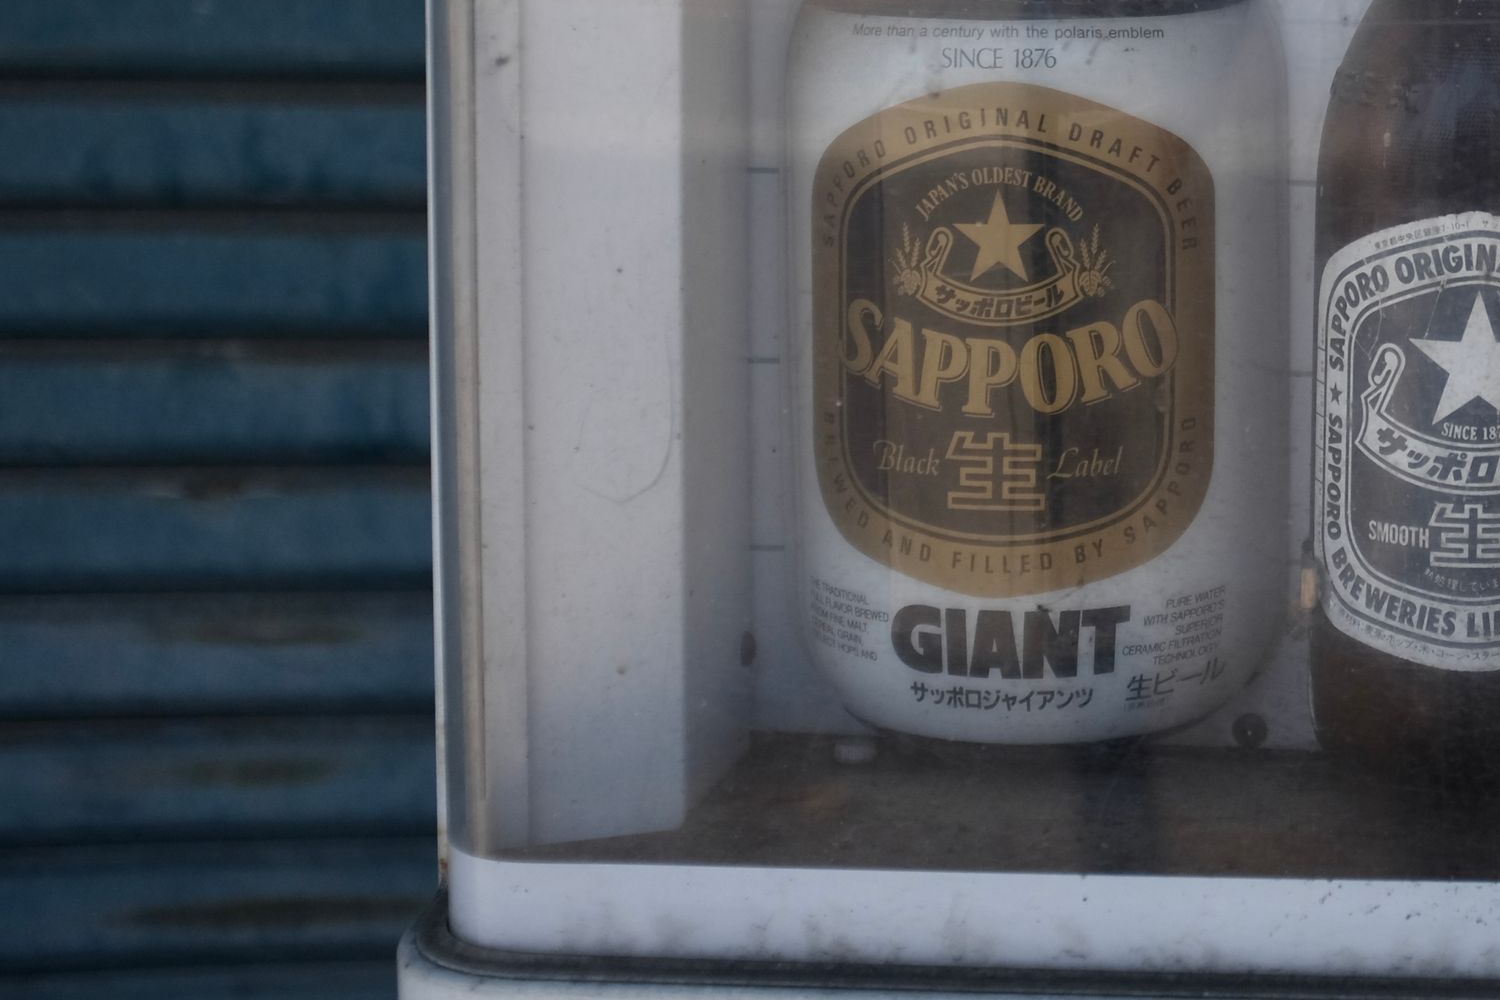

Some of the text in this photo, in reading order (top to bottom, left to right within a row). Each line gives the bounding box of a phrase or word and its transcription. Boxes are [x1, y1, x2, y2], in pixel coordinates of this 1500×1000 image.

[852, 24, 882, 37] More
[887, 25, 914, 37] than
[919, 28, 928, 37] a
[932, 27, 984, 40] century
[990, 25, 1019, 38] with
[1026, 25, 1049, 38] the
[1107, 26, 1165, 40] emblem
[941, 47, 1057, 69] SINCE 1876
[902, 107, 1048, 145] ORIGINAL
[1068, 122, 1161, 173] DRAFT
[1165, 178, 1199, 252] BEER
[914, 165, 1085, 223] JAPAN'S OLDEST BRAND
[934, 284, 1064, 318] サッポロビール
[1328, 265, 1390, 373] SAPPORO
[839, 299, 1180, 418] SAPPORO
[1441, 422, 1478, 441] SINCE
[872, 439, 940, 477] Black
[1046, 446, 1123, 480] Label
[1326, 413, 1343, 541] SAPPORO
[882, 530, 931, 563] AND
[951, 550, 1053, 575] FILLED
[1074, 539, 1105, 565] BY
[1123, 416, 1198, 545] SAPPORO
[1367, 519, 1430, 550] SMOOTH
[1166, 585, 1226, 609] PURE WATER
[1332, 546, 1457, 637] BREWERIES
[1143, 613, 1169, 627] WITH
[1175, 612, 1224, 636] SUPERIOR
[890, 603, 1131, 680] GIANT
[1121, 625, 1223, 657] CERAMIC FILTRATION
[910, 680, 1094, 712] サッポロジャイアンツ
[1125, 656, 1227, 701] 生ビール
